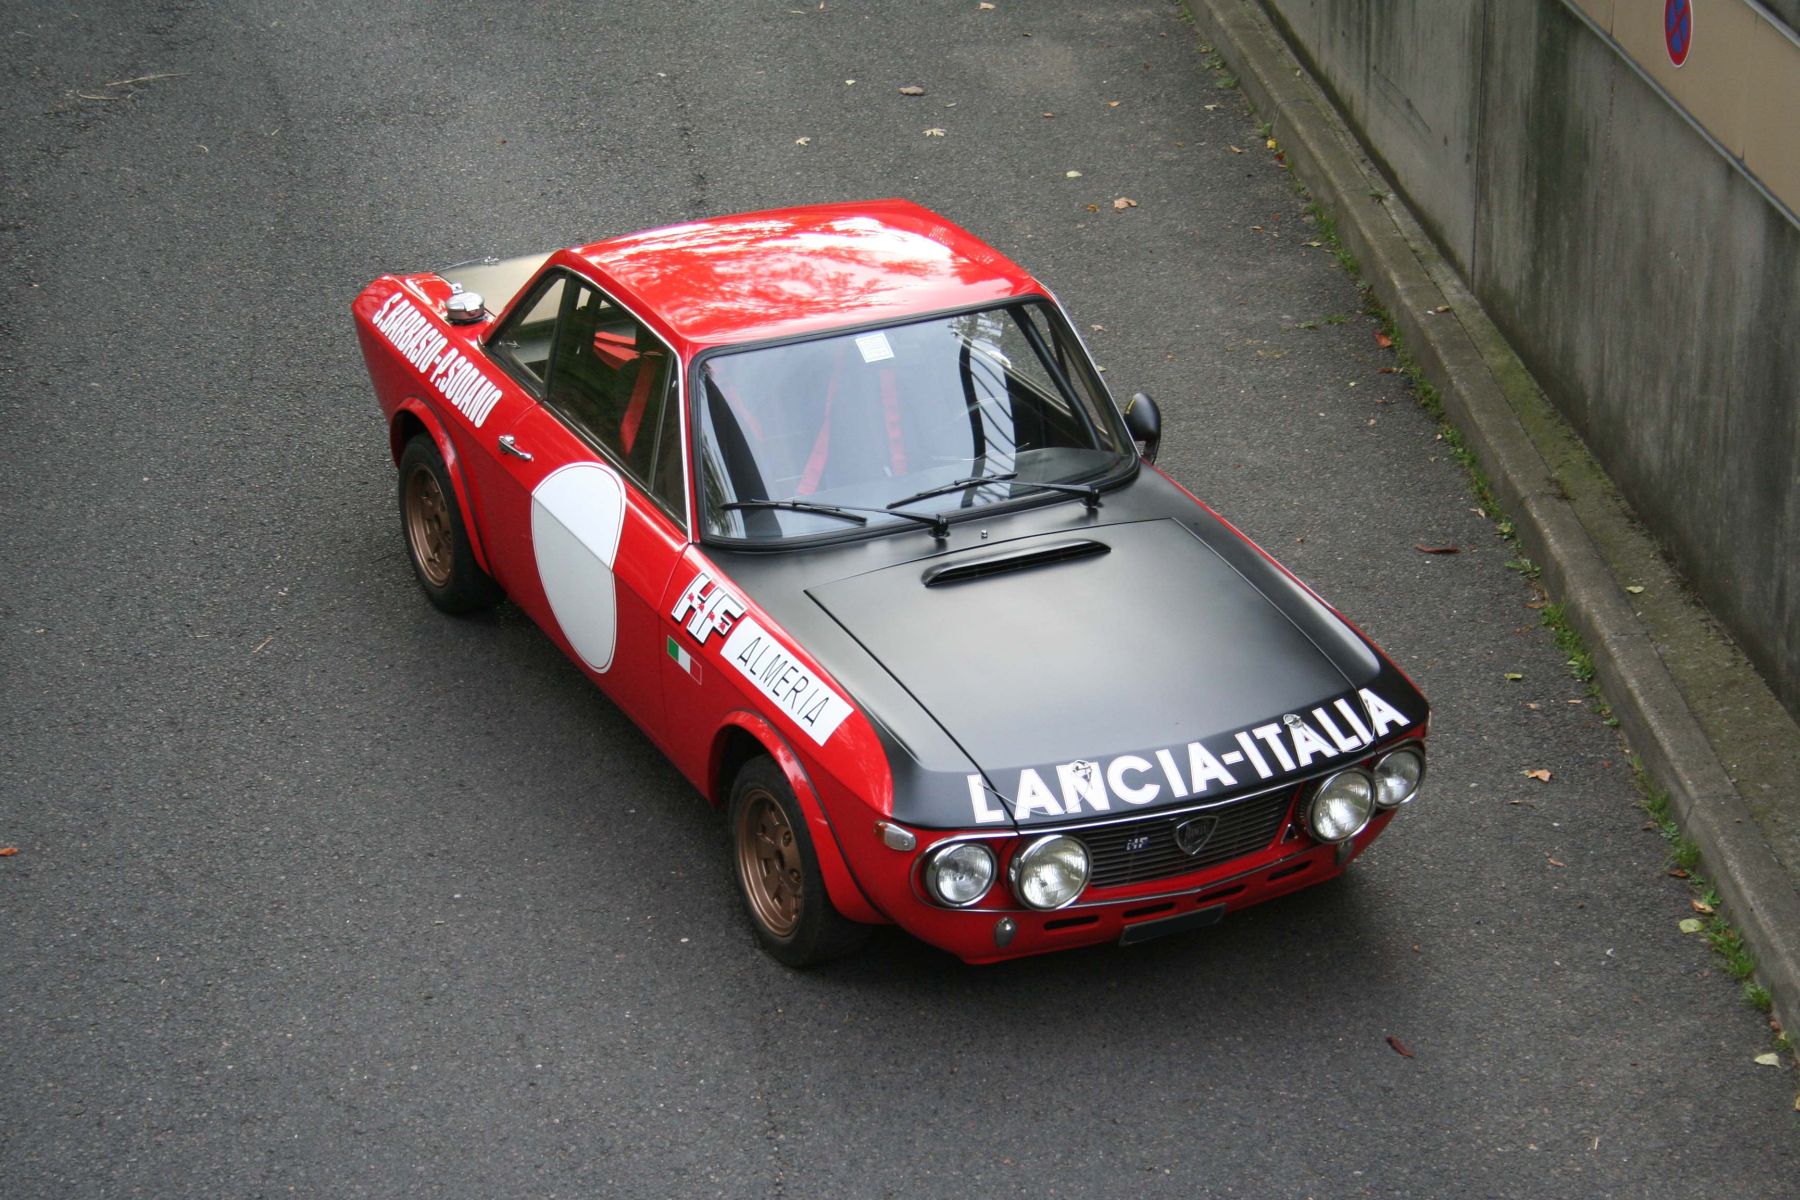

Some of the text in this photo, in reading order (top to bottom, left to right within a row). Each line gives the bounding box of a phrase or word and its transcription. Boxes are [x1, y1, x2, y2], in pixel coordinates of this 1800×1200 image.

[372, 292, 503, 428] S.BARBASIO-P.SODANO
[671, 571, 748, 644] HF
[736, 636, 829, 727] ALMERIA
[967, 687, 1410, 823] LANCIA-ITALIA
